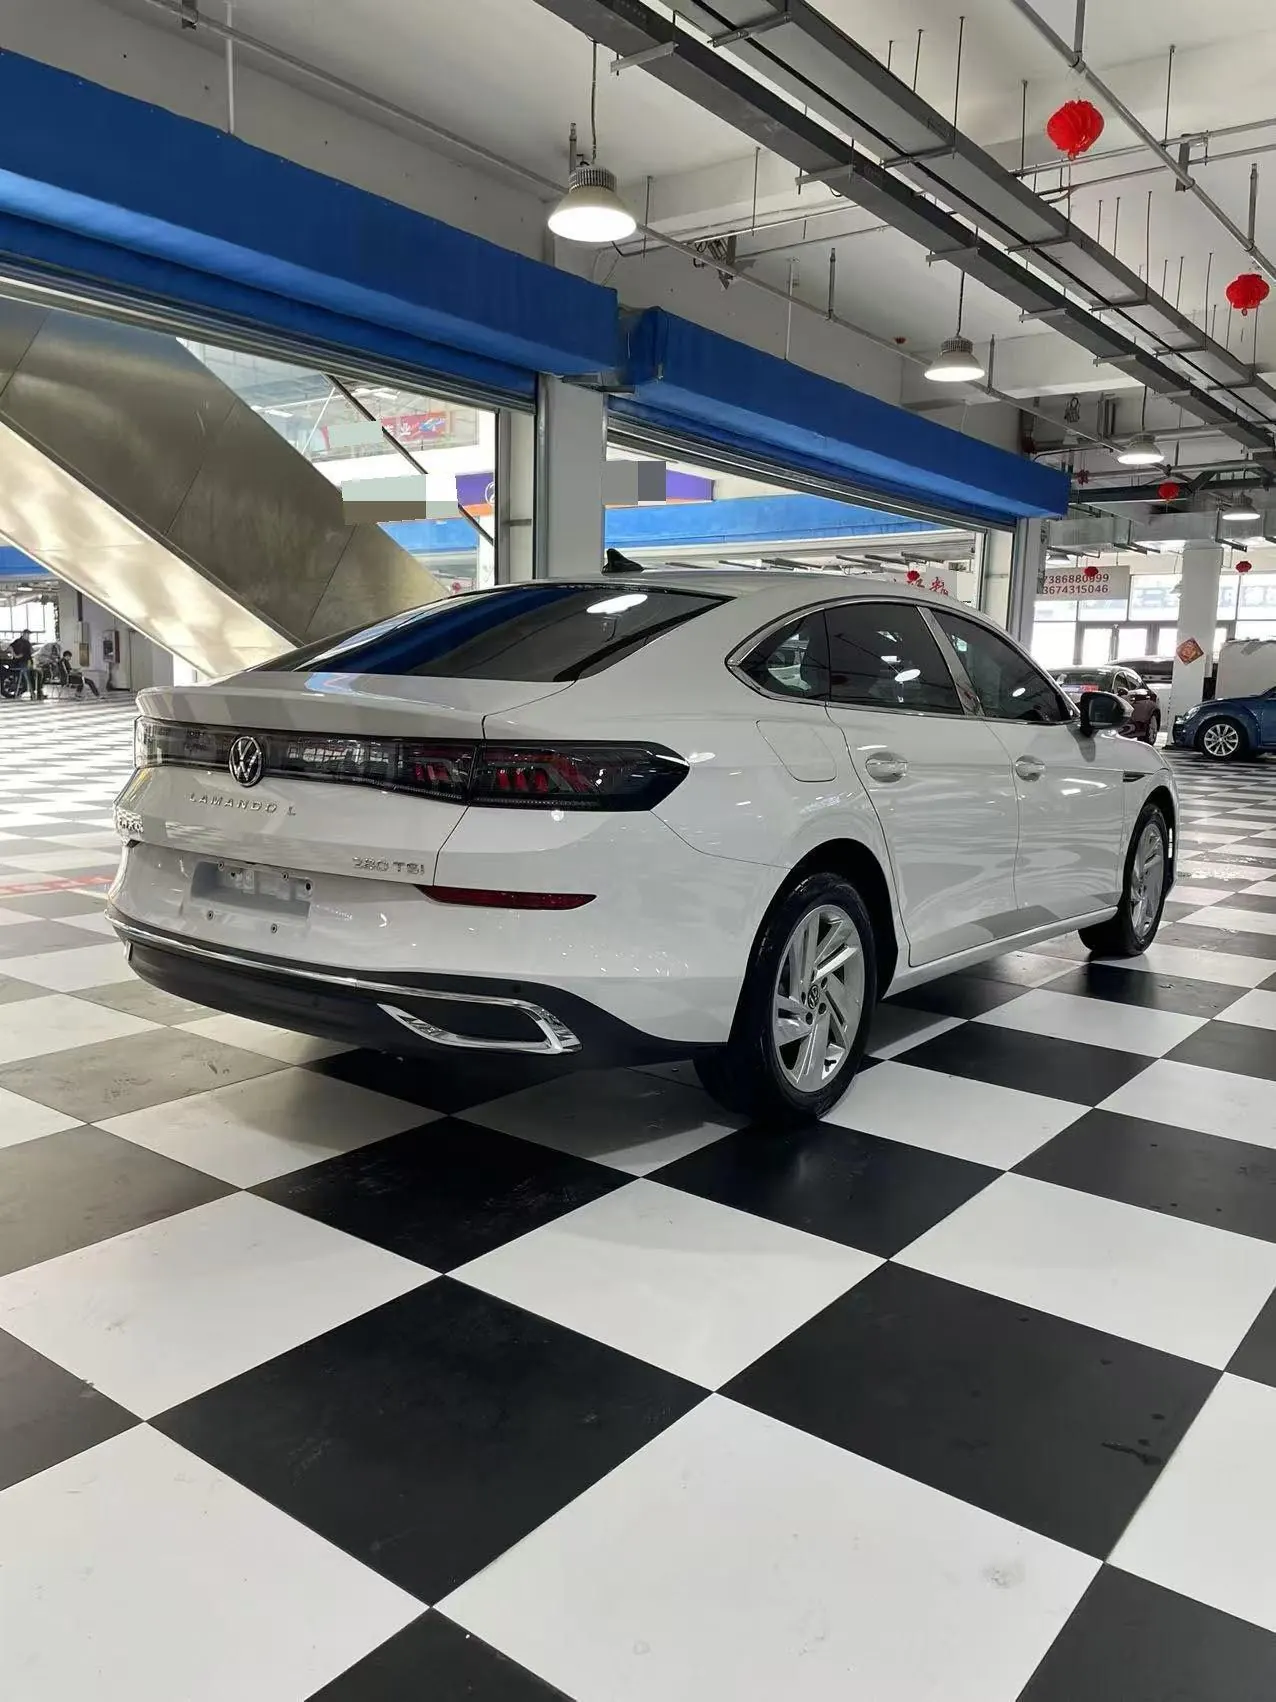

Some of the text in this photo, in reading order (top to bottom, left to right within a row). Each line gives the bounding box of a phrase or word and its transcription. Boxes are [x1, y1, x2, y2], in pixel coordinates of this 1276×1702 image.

[1042, 584, 1108, 595] 3674315046
[189, 792, 297, 816] LAMANDO L
